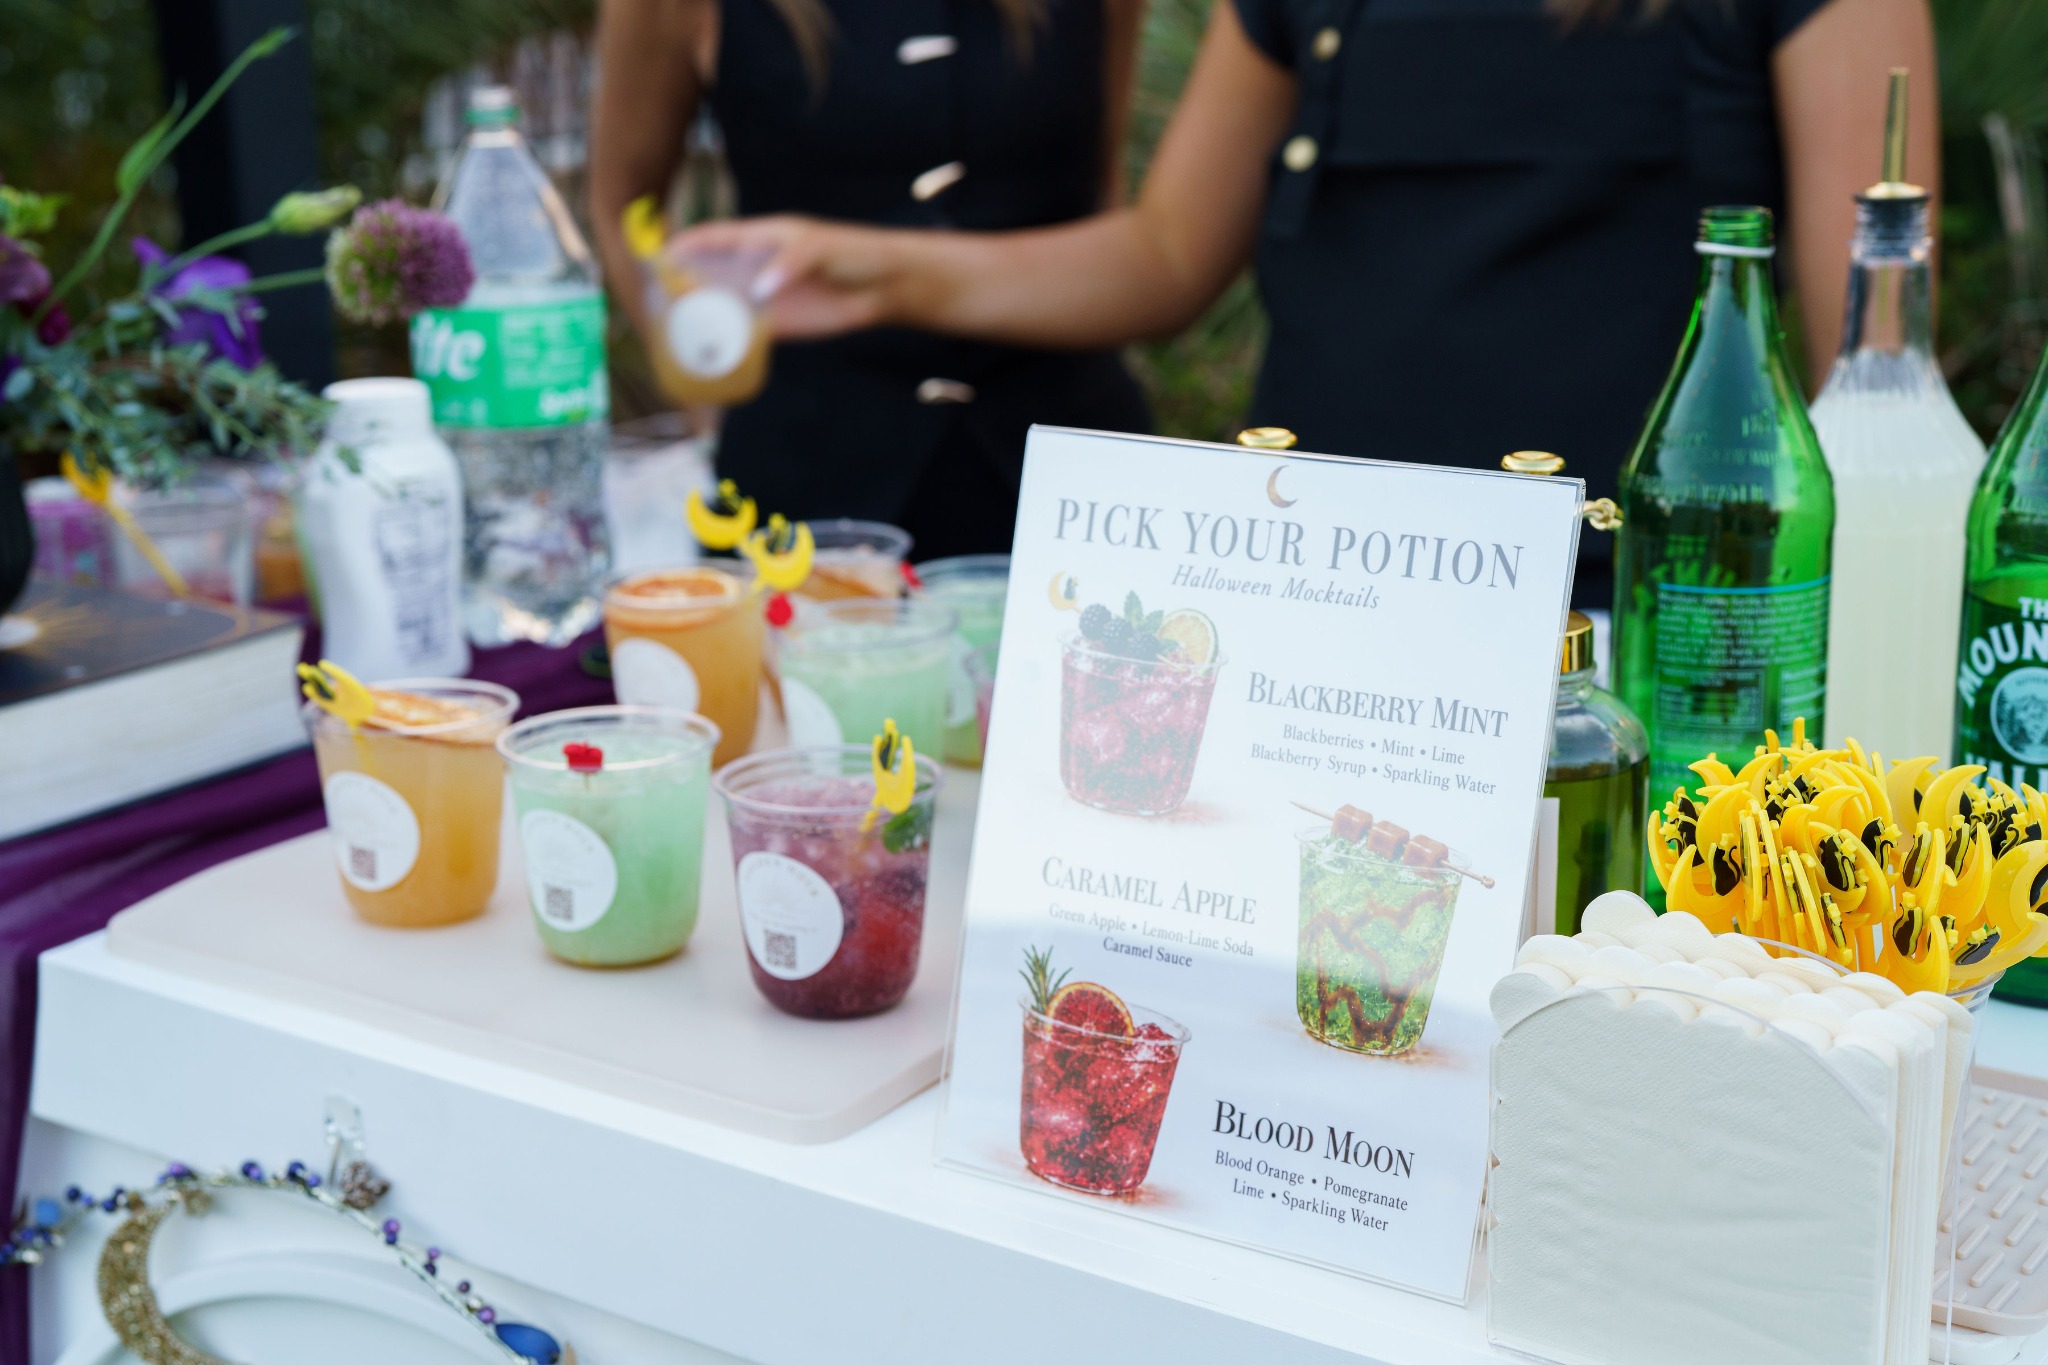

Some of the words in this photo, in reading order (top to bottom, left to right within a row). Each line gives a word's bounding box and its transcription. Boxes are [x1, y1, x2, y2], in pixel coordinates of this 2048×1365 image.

[1053, 498, 1164, 550] PICK
[1182, 511, 1306, 566] YOUR
[1327, 526, 1525, 590] POTION
[1170, 564, 1272, 597] Halloween
[1279, 577, 1381, 610] Mocktails
[1248, 671, 1424, 726] BLACKBERRY
[1430, 696, 1509, 738] MINT
[1251, 743, 1321, 771] Blackberry
[1327, 755, 1366, 778] Syrup
[1383, 763, 1451, 792] Sparkling
[1455, 774, 1497, 795] Water
[1283, 724, 1365, 750] Blackberries
[1381, 738, 1415, 758] Mint
[1431, 745, 1465, 765] Lime
[1042, 856, 1163, 907] CARAMEL
[1171, 880, 1257, 924] APPLE
[1049, 902, 1085, 924] Green
[1089, 911, 1127, 933] Apple
[1142, 920, 1219, 950] Lemon-Lime
[1223, 937, 1254, 957] Soda
[1103, 936, 1153, 959] Caramel
[1156, 946, 1193, 967] Sauce
[1212, 1099, 1314, 1153] BLOOD
[1323, 1125, 1415, 1179] MOON
[1215, 1149, 1252, 1172] Blood
[1256, 1160, 1304, 1186] Orange
[1324, 1176, 1408, 1211] Pomegranate
[1233, 1178, 1265, 1200] Lime
[1282, 1190, 1346, 1224] Sparkling
[1350, 1207, 1389, 1232] Water
